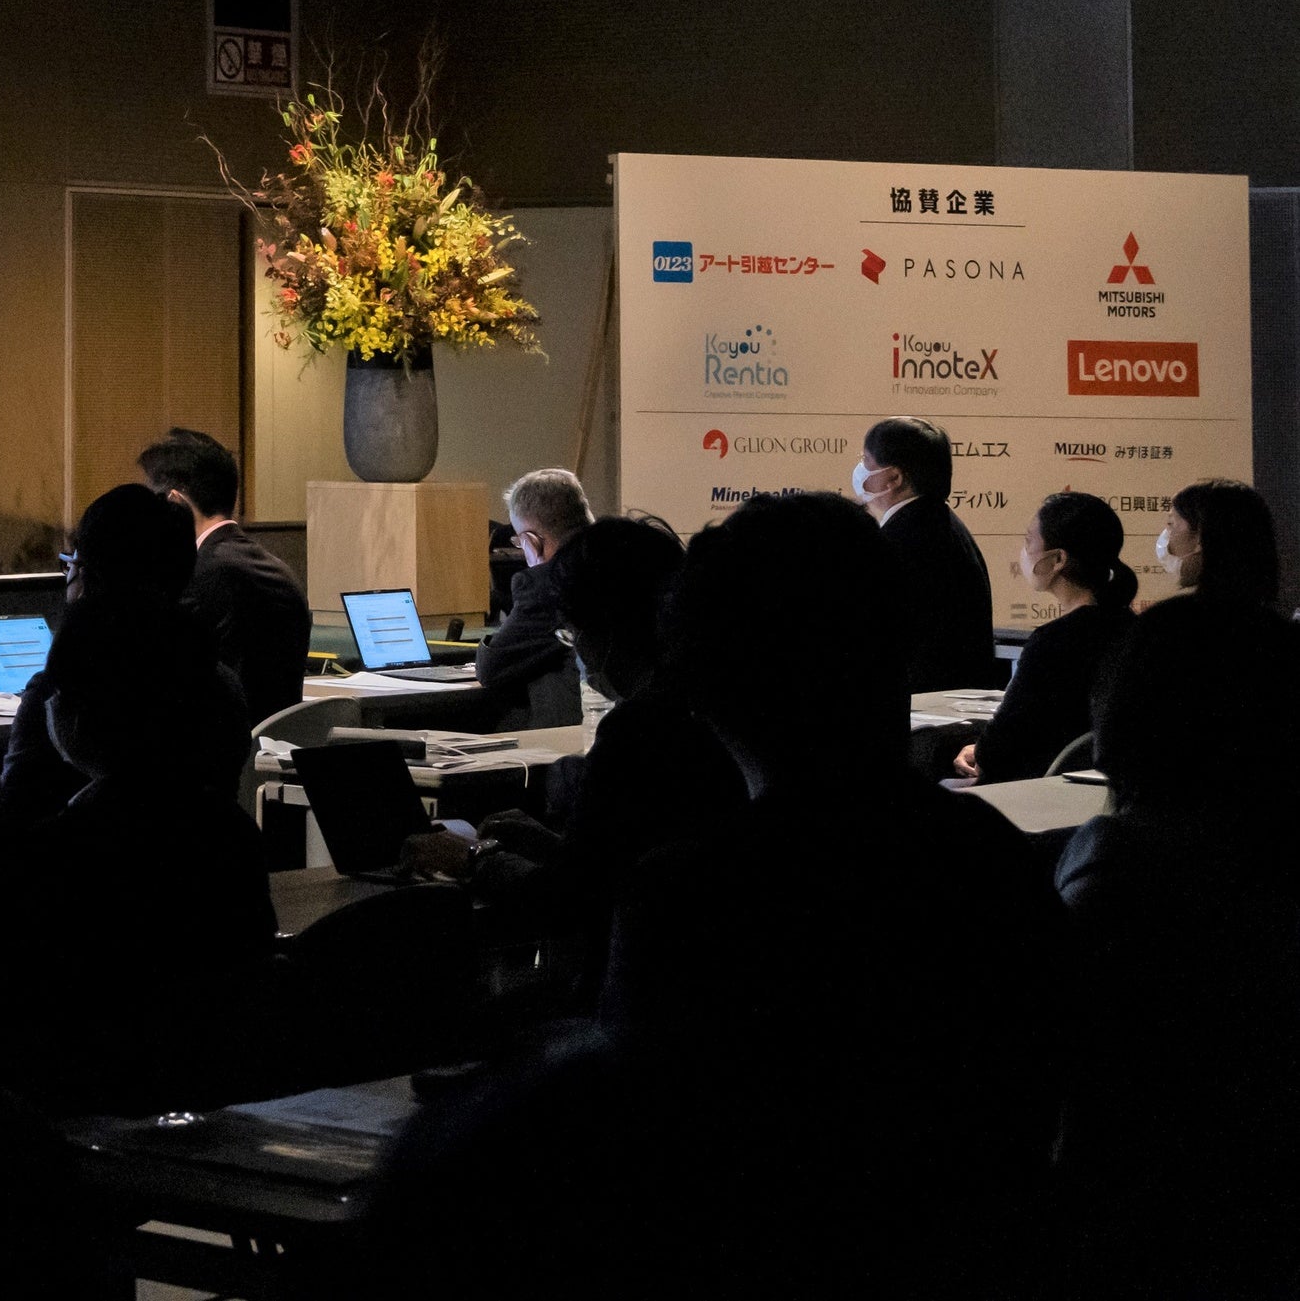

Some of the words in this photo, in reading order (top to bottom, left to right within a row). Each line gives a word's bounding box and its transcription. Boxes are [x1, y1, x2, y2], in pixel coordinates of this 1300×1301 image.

[889, 186, 997, 217] 協賛企業
[653, 253, 692, 274] 0123
[699, 253, 836, 276] アート引越センター
[903, 257, 1026, 282] PASONA
[1098, 290, 1166, 305] MITSUBISHI
[1106, 305, 1157, 319] MOTORS
[705, 354, 789, 386] Rentia
[1077, 350, 1189, 384] Lenovo
[903, 384, 951, 395] Innovation
[953, 384, 999, 397] Company
[734, 436, 787, 454] GLION
[789, 437, 848, 454] GROUP
[1053, 441, 1107, 457] MIZUHO
[1114, 445, 1174, 460] みずほ証券
